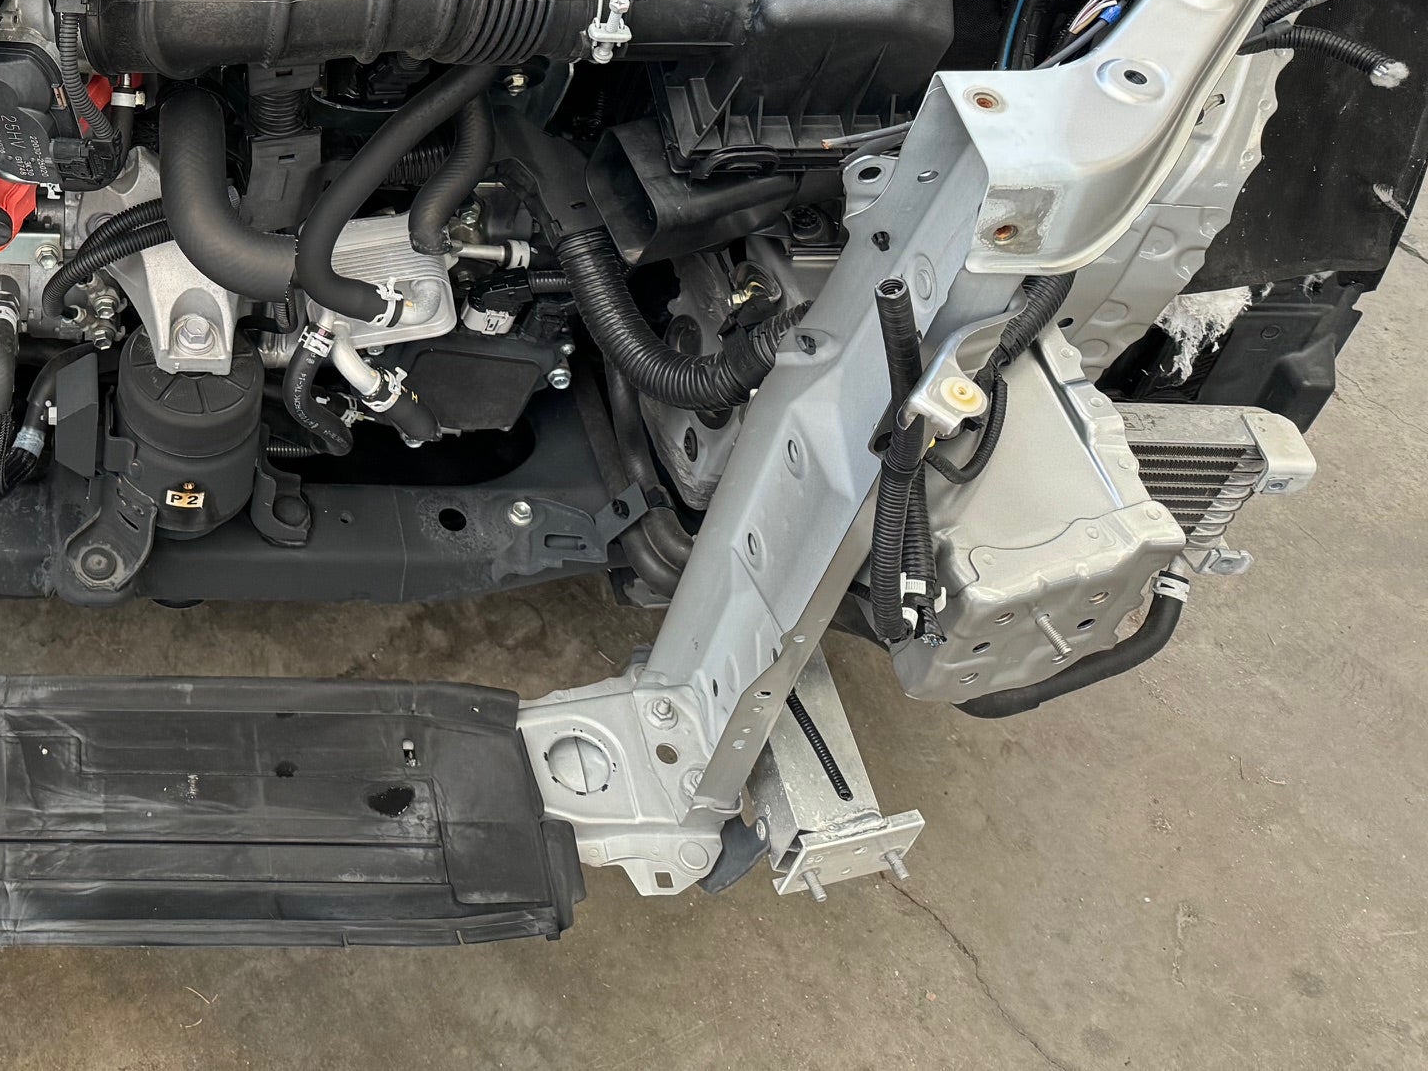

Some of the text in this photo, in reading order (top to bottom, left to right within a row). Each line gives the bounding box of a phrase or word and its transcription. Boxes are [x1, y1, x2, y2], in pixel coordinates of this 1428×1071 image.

[0, 114, 27, 149] 25HV
[170, 493, 199, 505] P 2
